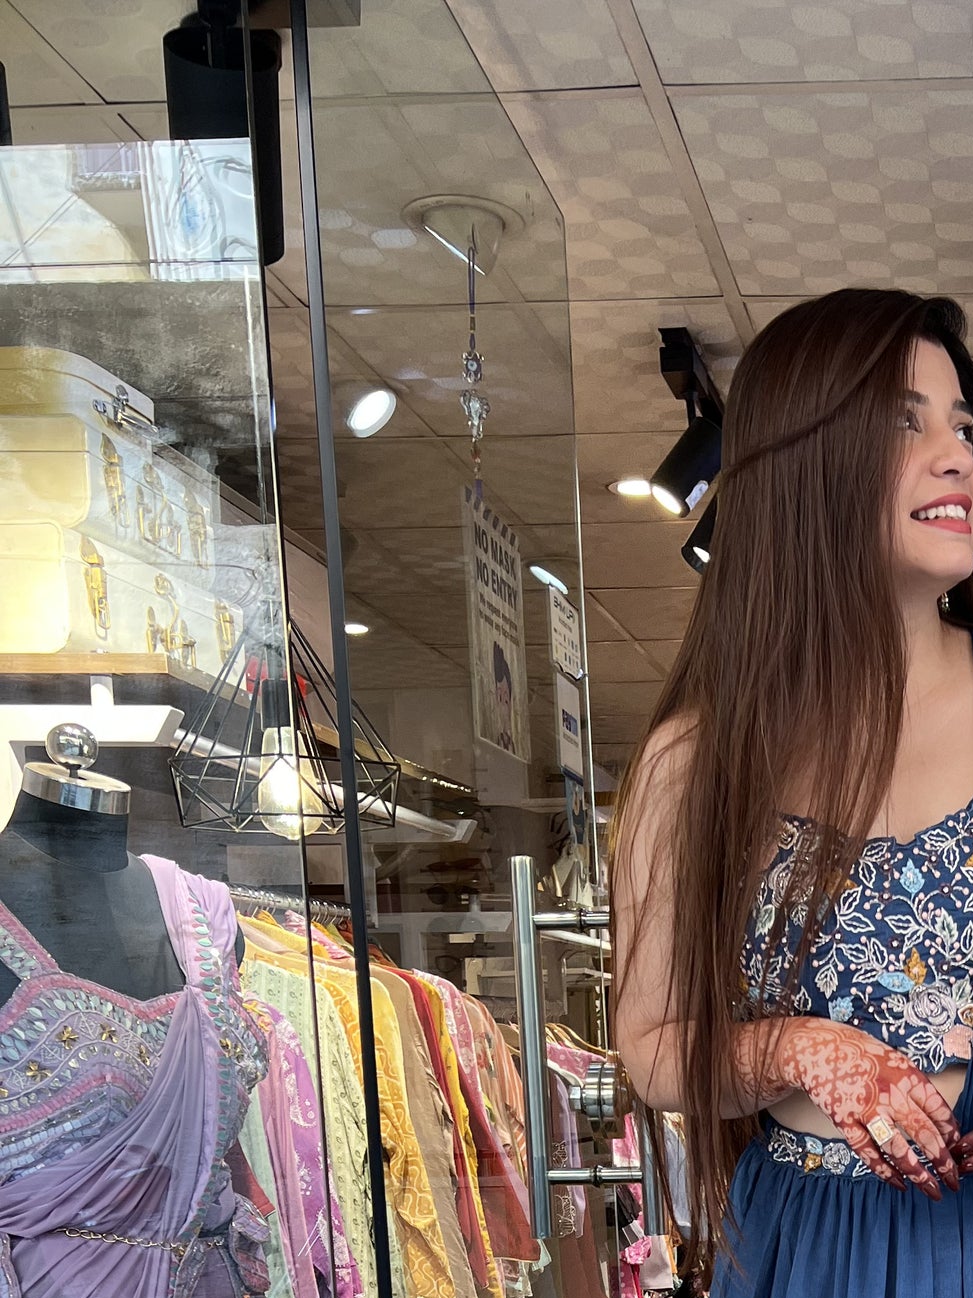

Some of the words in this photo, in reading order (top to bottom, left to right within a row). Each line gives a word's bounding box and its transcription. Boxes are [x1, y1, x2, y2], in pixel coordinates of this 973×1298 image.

[474, 521, 488, 554] NO
[490, 536, 517, 581] MASK
[475, 556, 489, 587] NO
[491, 568, 517, 611] ENTRY
